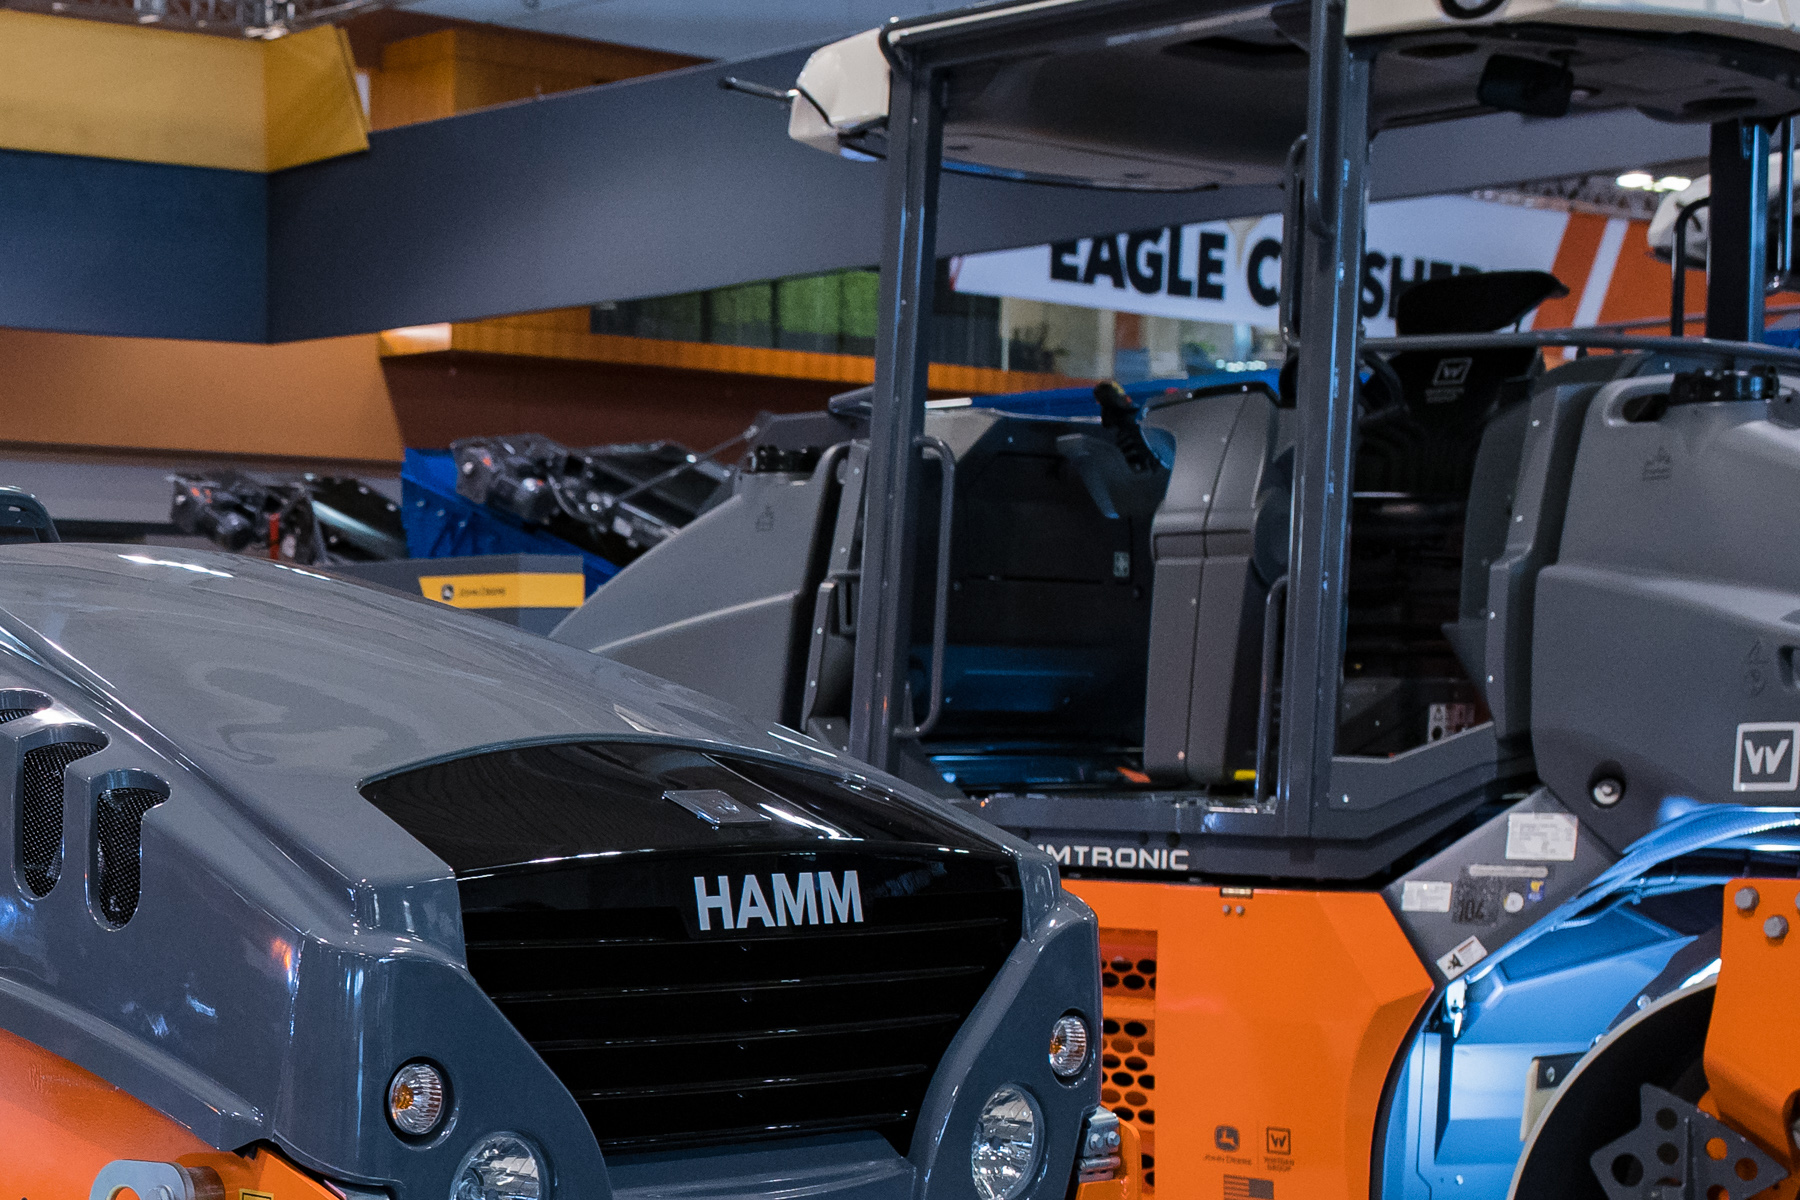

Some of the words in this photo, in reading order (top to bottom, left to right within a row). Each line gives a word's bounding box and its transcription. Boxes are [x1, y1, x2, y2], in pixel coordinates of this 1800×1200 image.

[1050, 227, 1226, 300] EAGLE
[1037, 844, 1190, 871] MTRONIC
[693, 869, 864, 931] HAMM
